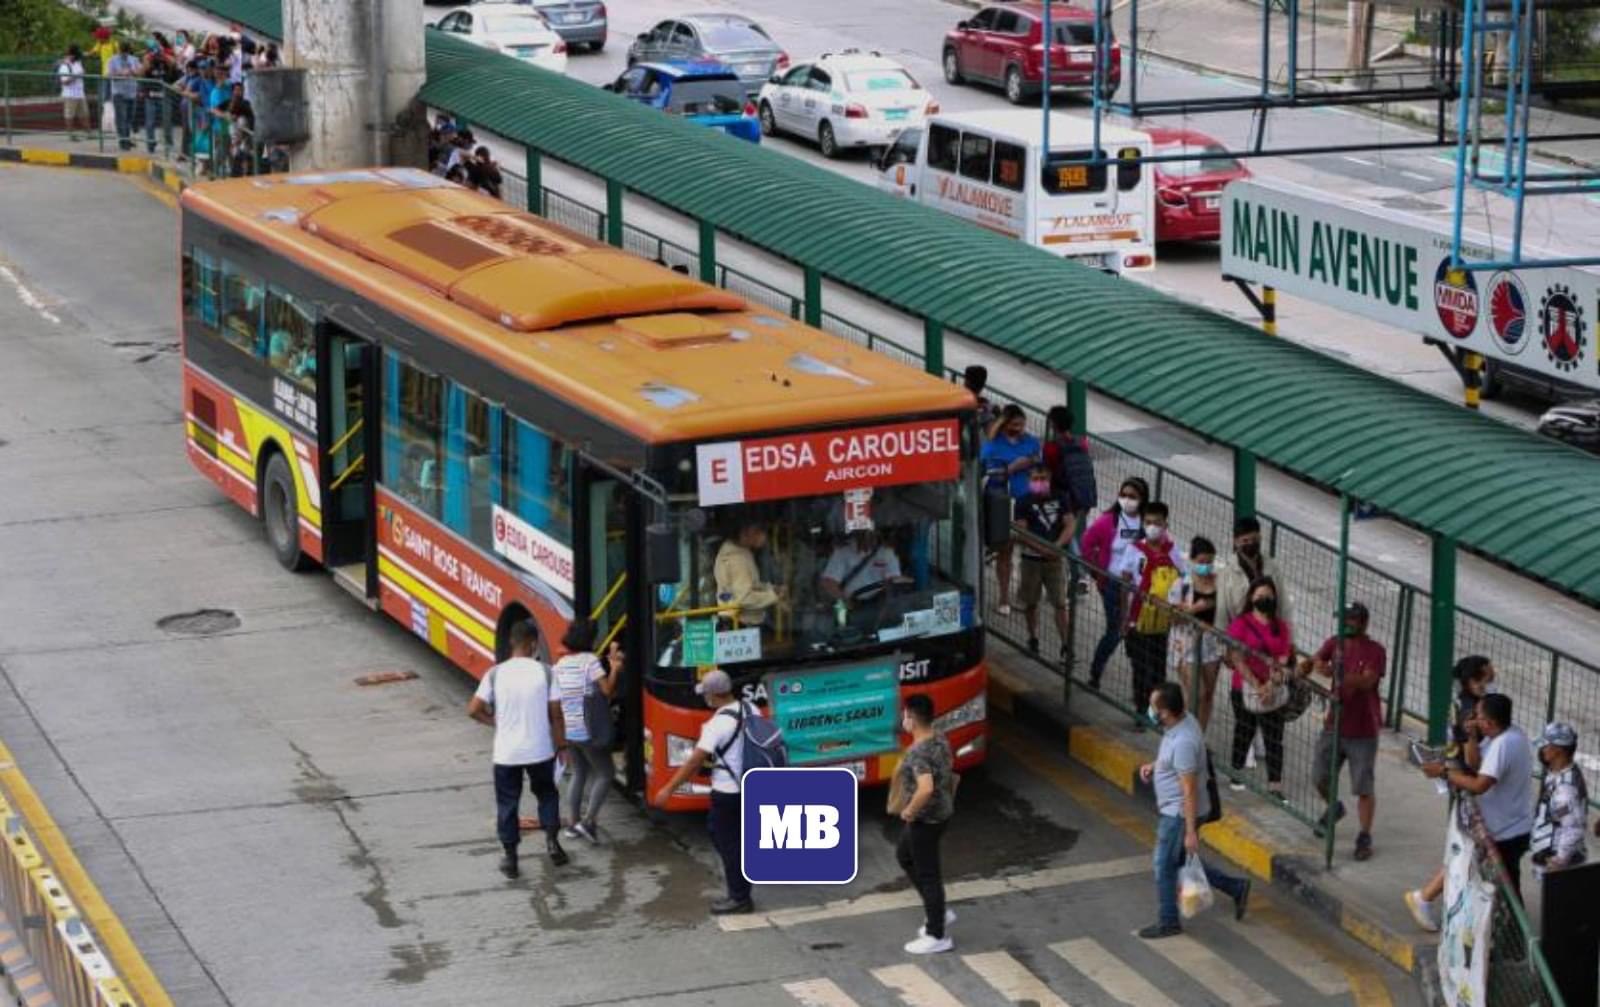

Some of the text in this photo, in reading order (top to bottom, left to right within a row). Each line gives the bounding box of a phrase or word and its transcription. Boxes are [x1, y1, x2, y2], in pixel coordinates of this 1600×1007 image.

[950, 180, 1012, 217] LALAMOVE
[1063, 213, 1133, 228] LALAMOVE
[1232, 198, 1419, 310] MAIN AVENUE
[1438, 285, 1476, 313] MMDA
[745, 427, 959, 473] EDSA CAROUSEL
[711, 458, 729, 484] E
[824, 463, 892, 482] AIRCON
[403, 525, 431, 561] SAINT
[460, 562, 502, 609] TRANSIT
[532, 540, 575, 582] CAROUSE
